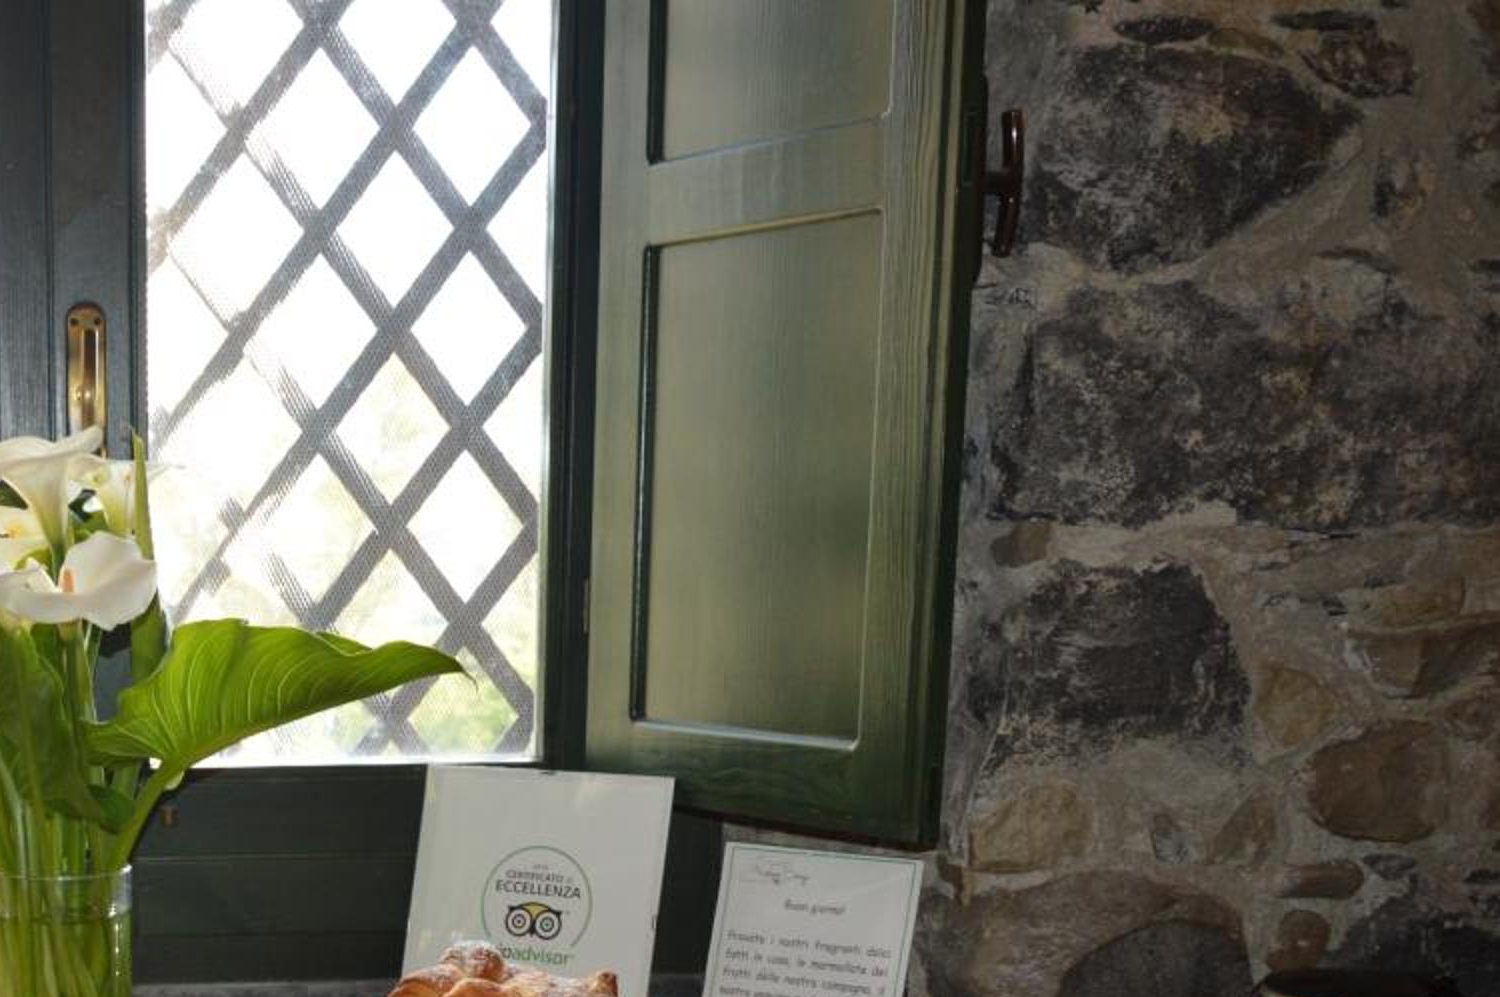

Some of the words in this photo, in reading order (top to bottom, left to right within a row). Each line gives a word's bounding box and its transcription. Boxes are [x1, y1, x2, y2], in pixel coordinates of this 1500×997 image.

[495, 879, 581, 899] ECCELLENZA
[497, 943, 568, 965] ipadvisor
[779, 937, 809, 949] nostri
[815, 940, 861, 955] fragranti
